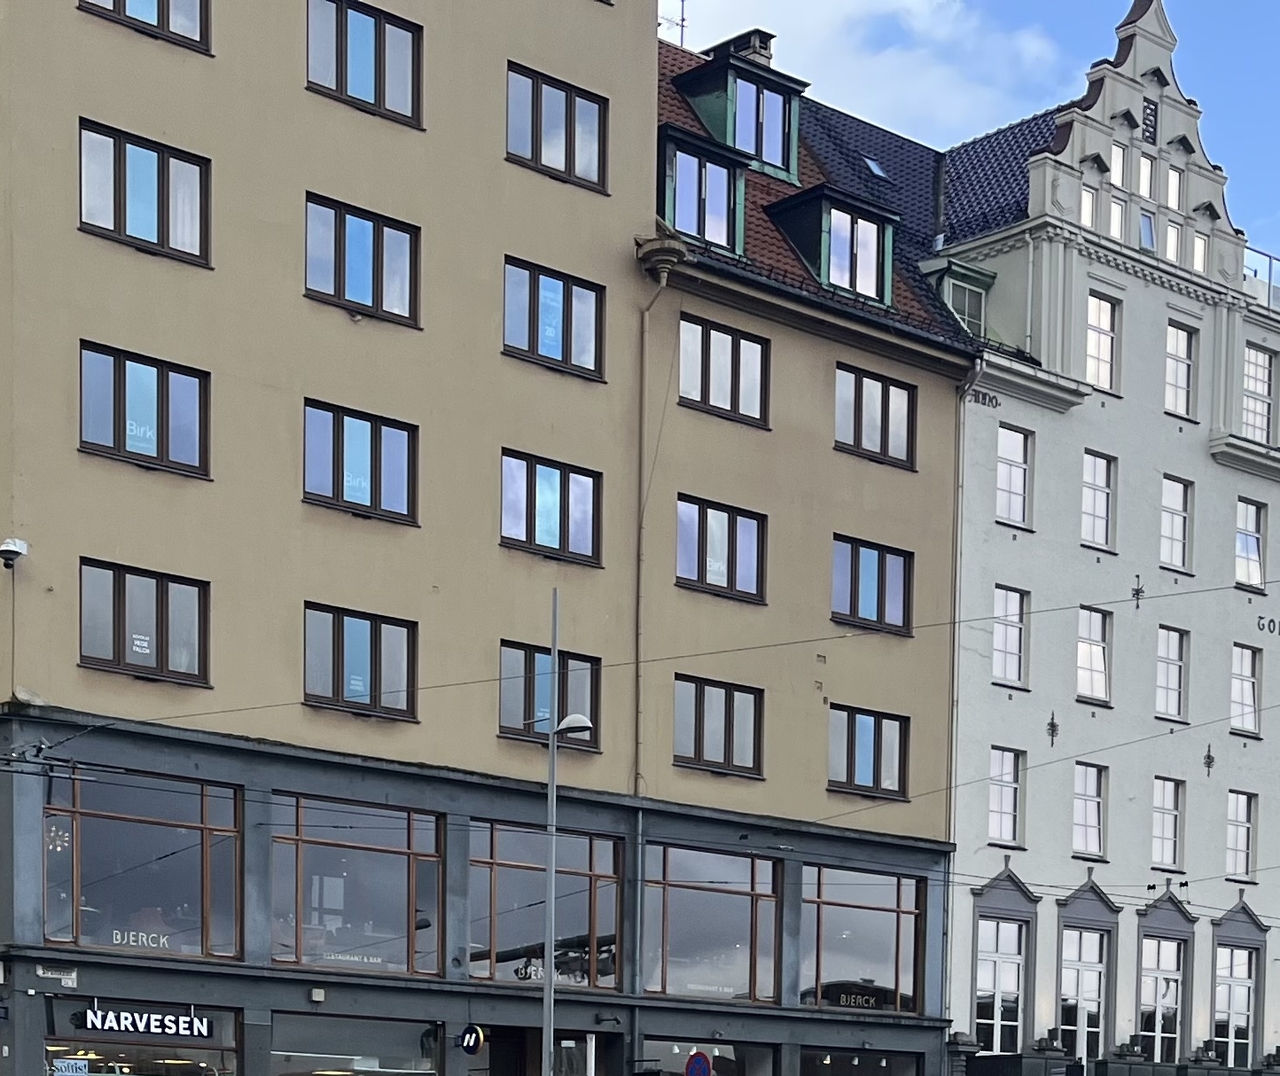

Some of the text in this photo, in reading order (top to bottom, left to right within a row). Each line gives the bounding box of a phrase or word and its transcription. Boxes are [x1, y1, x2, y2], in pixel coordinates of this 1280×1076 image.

[126, 420, 155, 441] Birk
[113, 930, 170, 949] BJERCK
[518, 964, 562, 981] BJERK
[840, 994, 876, 1008] BJERCK
[86, 1009, 208, 1037] NARVESEN
